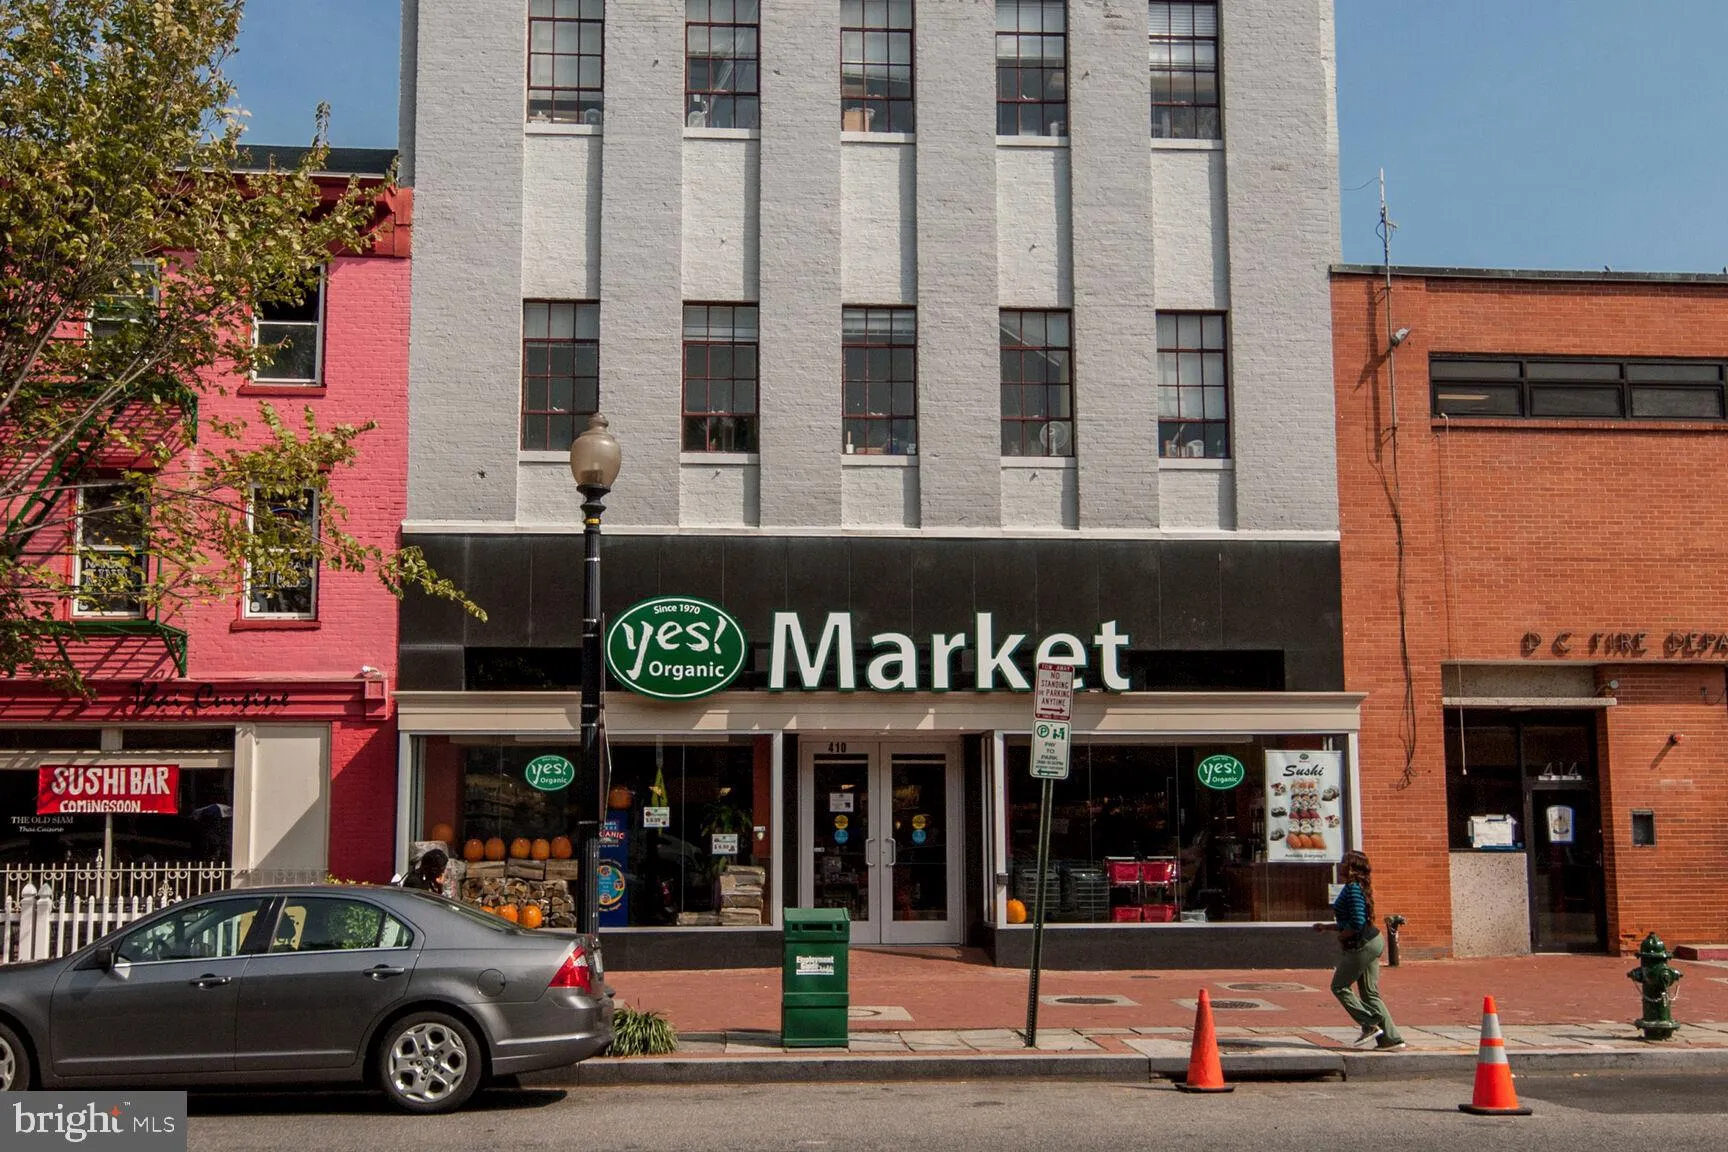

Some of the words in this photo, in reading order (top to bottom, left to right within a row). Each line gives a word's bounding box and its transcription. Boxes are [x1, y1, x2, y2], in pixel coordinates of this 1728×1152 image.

[653, 604, 678, 615] Since
[679, 604, 701, 615] 1970
[621, 615, 728, 681] yes!
[1592, 631, 1649, 653] FIRE
[769, 611, 1131, 690] Market
[648, 661, 725, 681] Organic
[1050, 671, 1061, 680] NO
[1041, 680, 1069, 690] STANDING
[131, 681, 182, 711] Thai
[193, 682, 290, 710] Cuisine
[1045, 689, 1070, 698] PARKING
[1041, 698, 1066, 707] ANYTIME
[828, 742, 847, 753] 410
[531, 761, 568, 785] yes!
[1203, 760, 1238, 784] yes!
[1282, 764, 1325, 777] Sushi
[1543, 762, 1581, 780] 414
[130, 766, 171, 795] BAR
[540, 777, 567, 785] Organic
[1212, 776, 1239, 784] Organic
[11, 816, 30, 825] THE
[31, 816, 51, 825] OLD
[52, 816, 74, 825] SIAM
